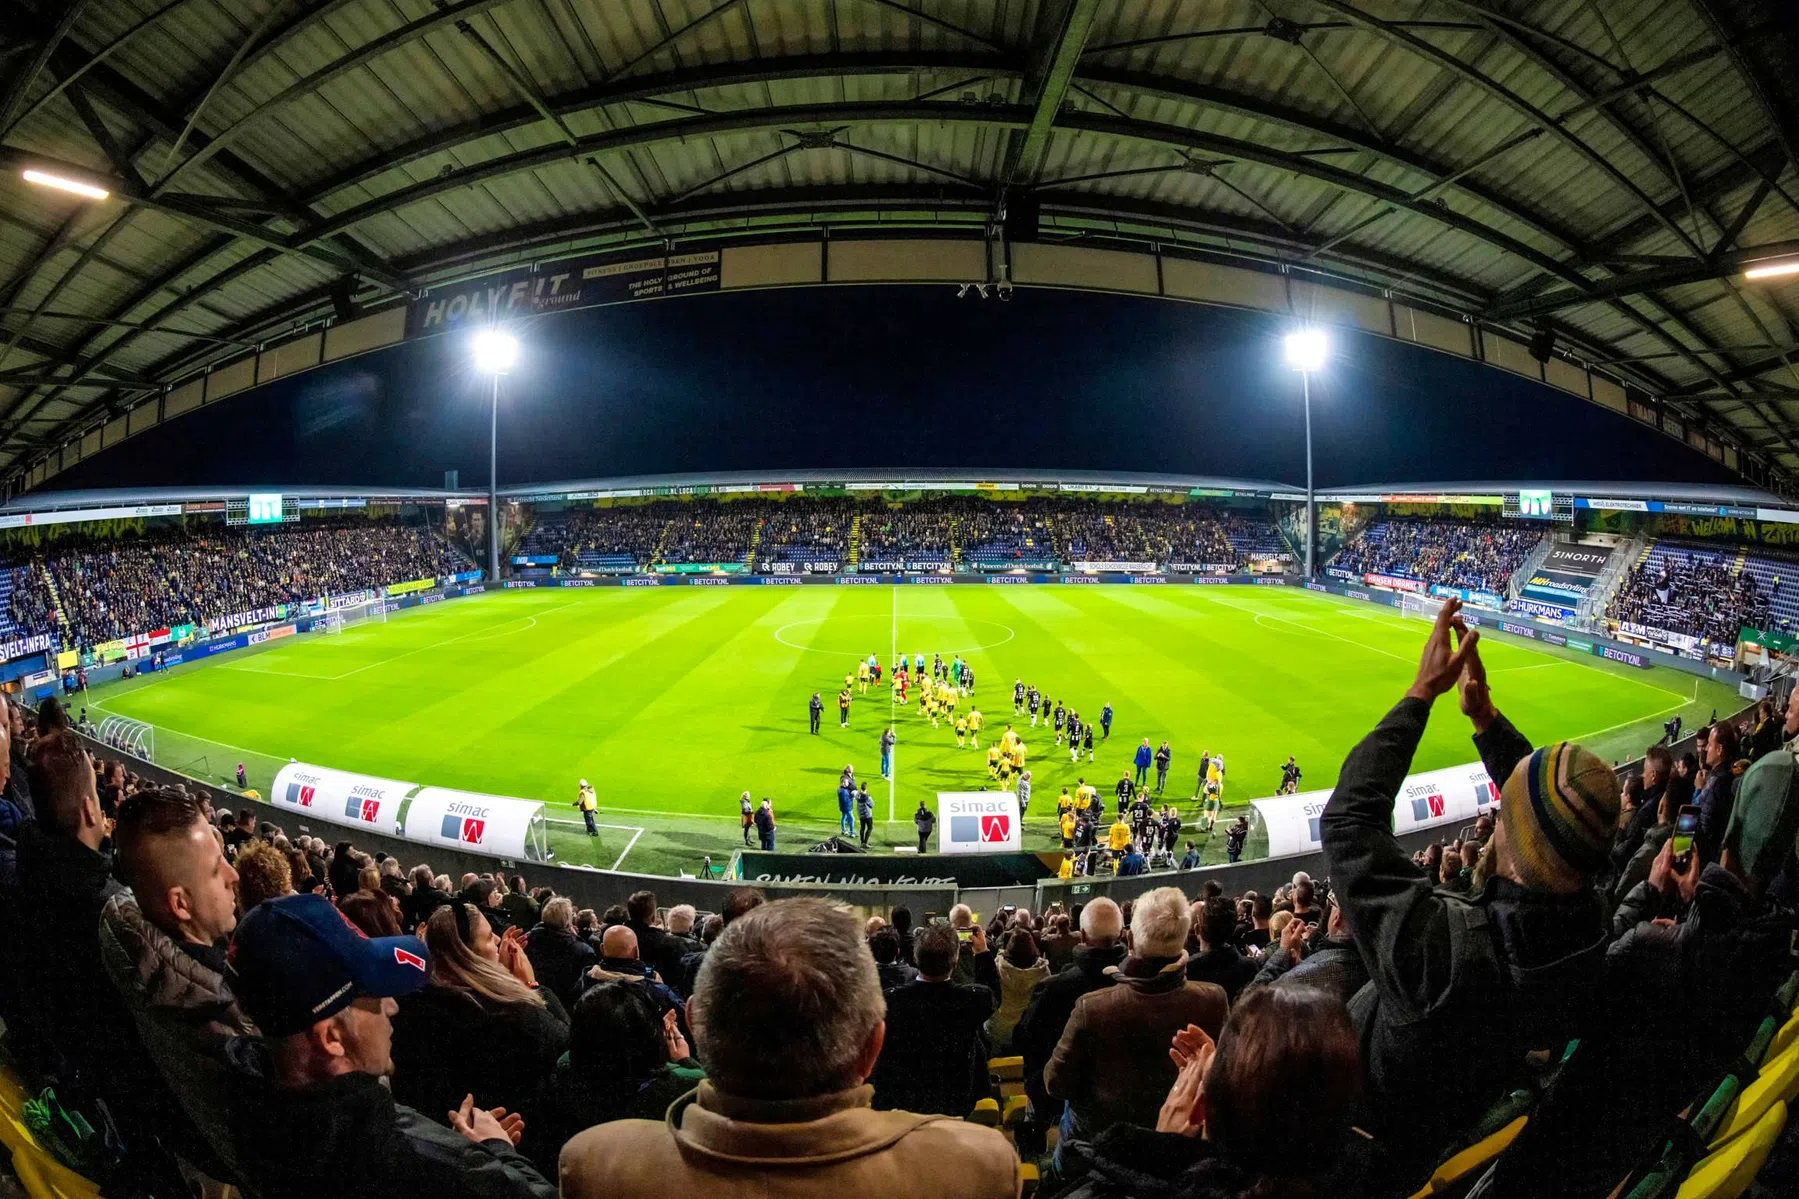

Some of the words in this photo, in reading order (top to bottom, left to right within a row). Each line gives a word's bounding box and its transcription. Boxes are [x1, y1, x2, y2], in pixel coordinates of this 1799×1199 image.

[694, 255, 715, 263] YOGA
[629, 281, 642, 290] THE
[644, 277, 663, 287] HOLY
[668, 270, 699, 282] GROUND
[702, 267, 713, 275] OF
[634, 285, 663, 297] SPORTS
[675, 275, 718, 289] WELLBEING
[772, 563, 795, 571] ROBEY
[814, 563, 838, 571] ROBEY
[864, 562, 905, 570] BETCITY.NL
[912, 562, 953, 570] BETCITY.NL
[508, 580, 536, 588] BETCITY.NL
[626, 579, 660, 587] BETCITY.NL
[991, 576, 1029, 584] BETCITY.NL
[1064, 576, 1100, 584] BETCITY.NL
[1134, 576, 1167, 584] BETCITY.NL
[1368, 575, 1392, 586] HANSEN
[1518, 601, 1563, 619] HURKMANS
[1503, 622, 1535, 638] BETCITY.NL
[257, 631, 272, 642] BLM
[1604, 647, 1641, 667] BETCITY.NL
[351, 785, 386, 800] simac
[447, 800, 490, 819] simac
[950, 799, 1008, 814] simac
